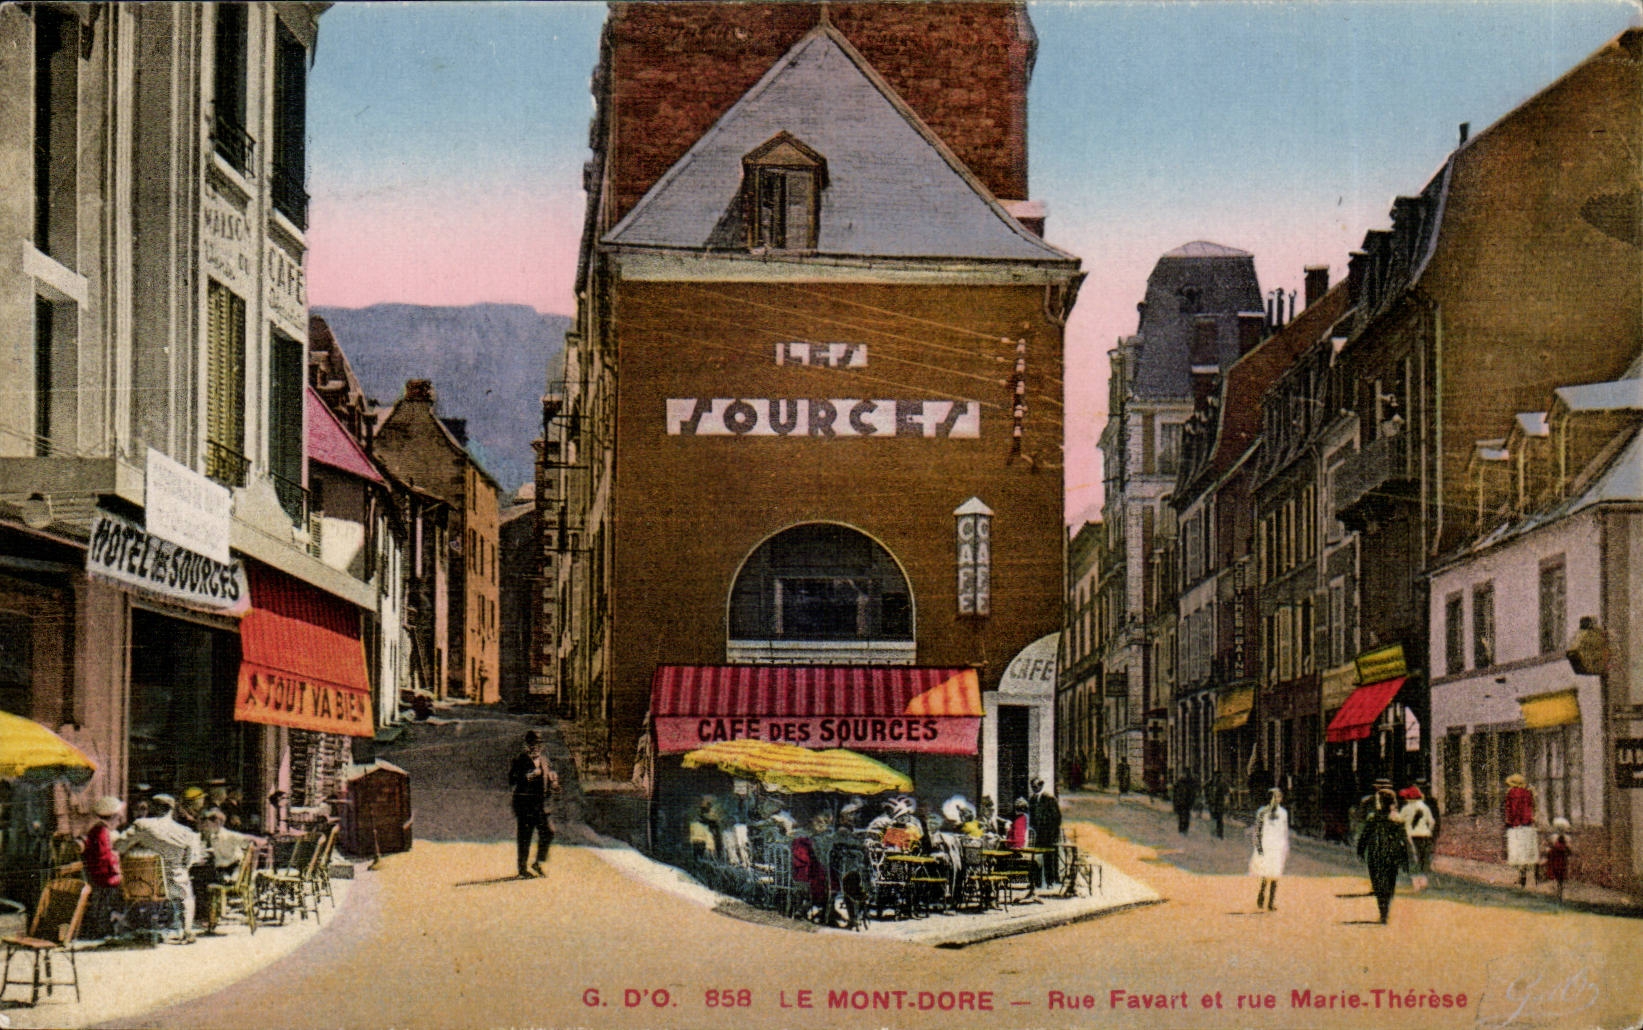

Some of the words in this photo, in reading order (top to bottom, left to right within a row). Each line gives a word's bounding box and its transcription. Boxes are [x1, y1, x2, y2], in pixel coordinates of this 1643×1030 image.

[776, 342, 868, 368] LES
[665, 397, 981, 439] SOURCES
[92, 517, 150, 578] HOTEL
[168, 546, 240, 601] SOURCES
[311, 685, 332, 719] VA
[769, 722, 811, 742] DES
[819, 718, 939, 742] SOURCES
